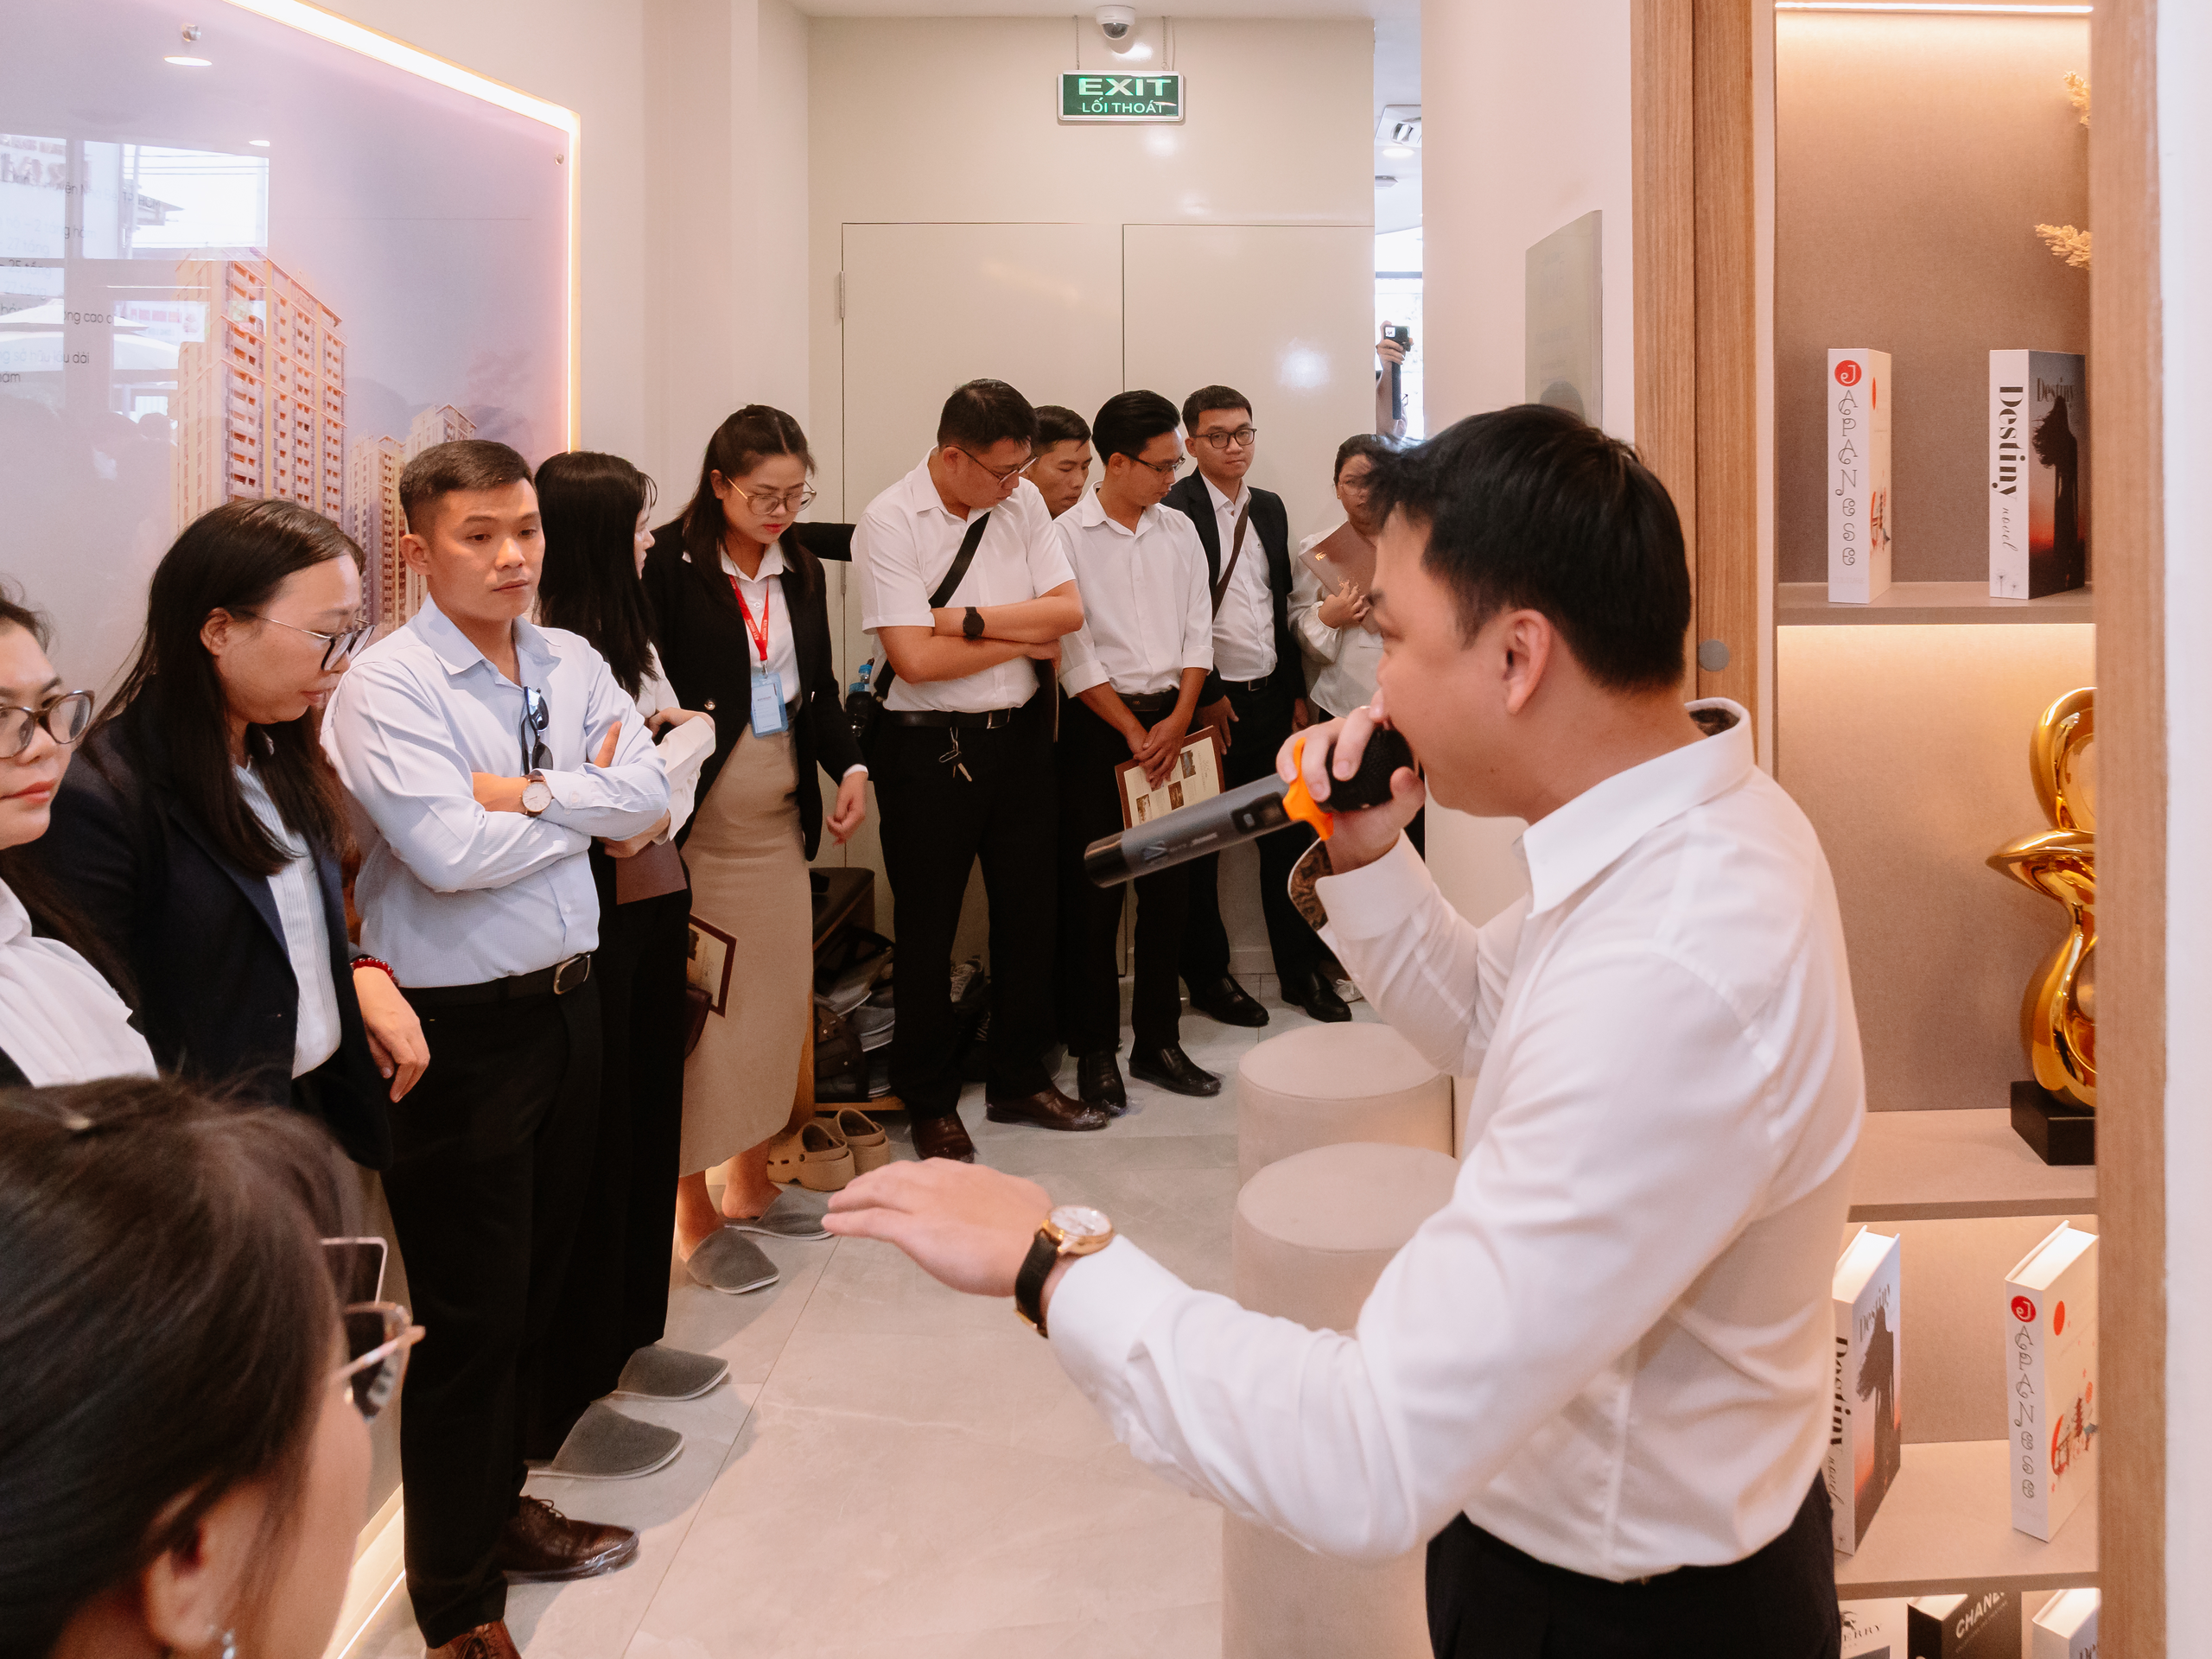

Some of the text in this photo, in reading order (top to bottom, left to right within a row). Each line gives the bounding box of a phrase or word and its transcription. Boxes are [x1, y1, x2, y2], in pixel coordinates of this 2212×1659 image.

[1079, 78, 1171, 96] EXIT
[1082, 97, 1163, 113] LỐI THOÁT
[1993, 386, 2025, 500] Destiny
[1956, 1592, 2005, 1638] CHANE
